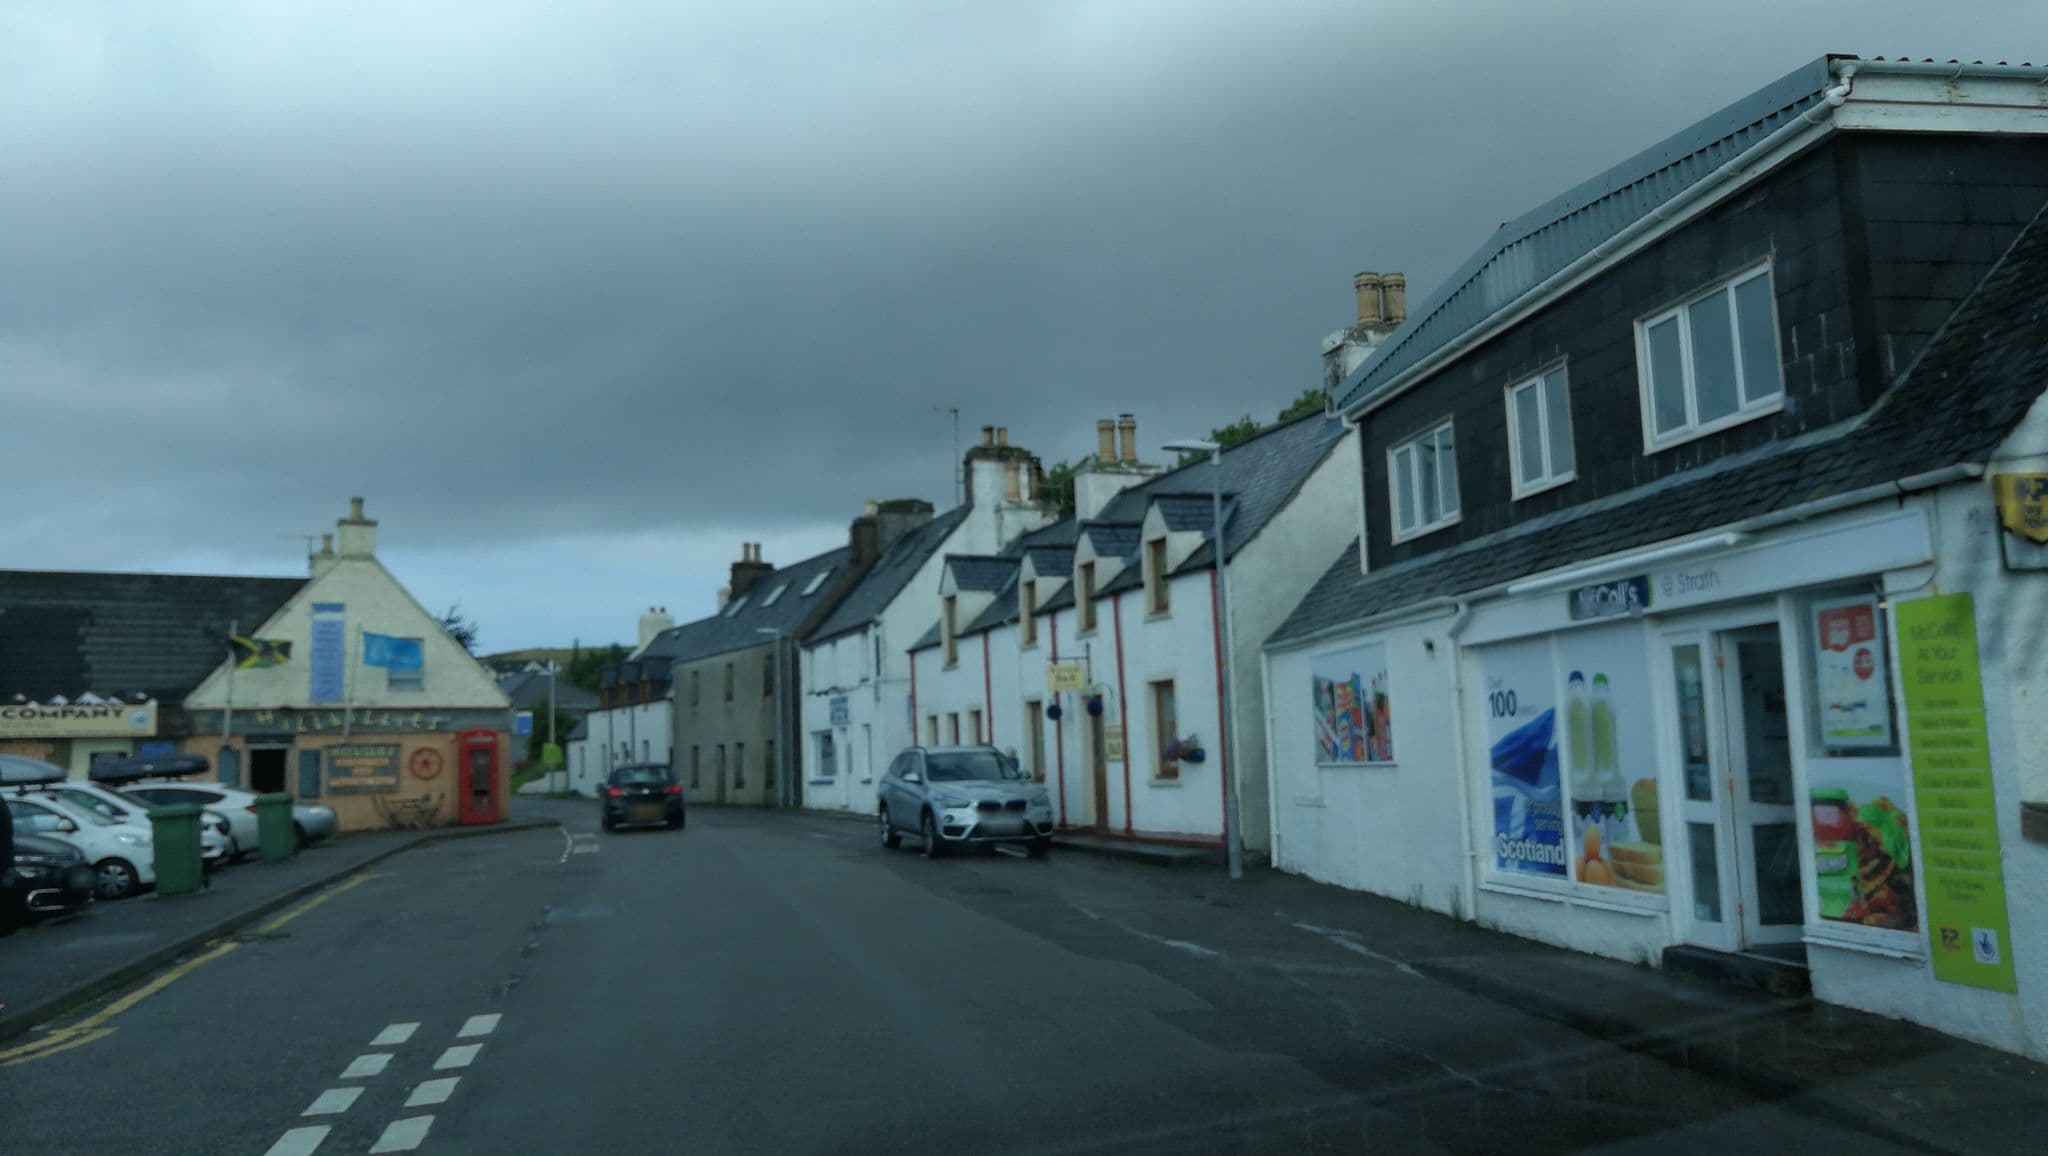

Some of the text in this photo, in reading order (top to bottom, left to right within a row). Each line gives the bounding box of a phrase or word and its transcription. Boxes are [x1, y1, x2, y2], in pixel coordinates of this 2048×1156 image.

[1677, 568, 1721, 593] Strath
[1916, 668, 1963, 684] Service
[1, 706, 125, 721] COMPANY
[1489, 689, 1518, 718] 100
[1498, 832, 1566, 865] Scotland
